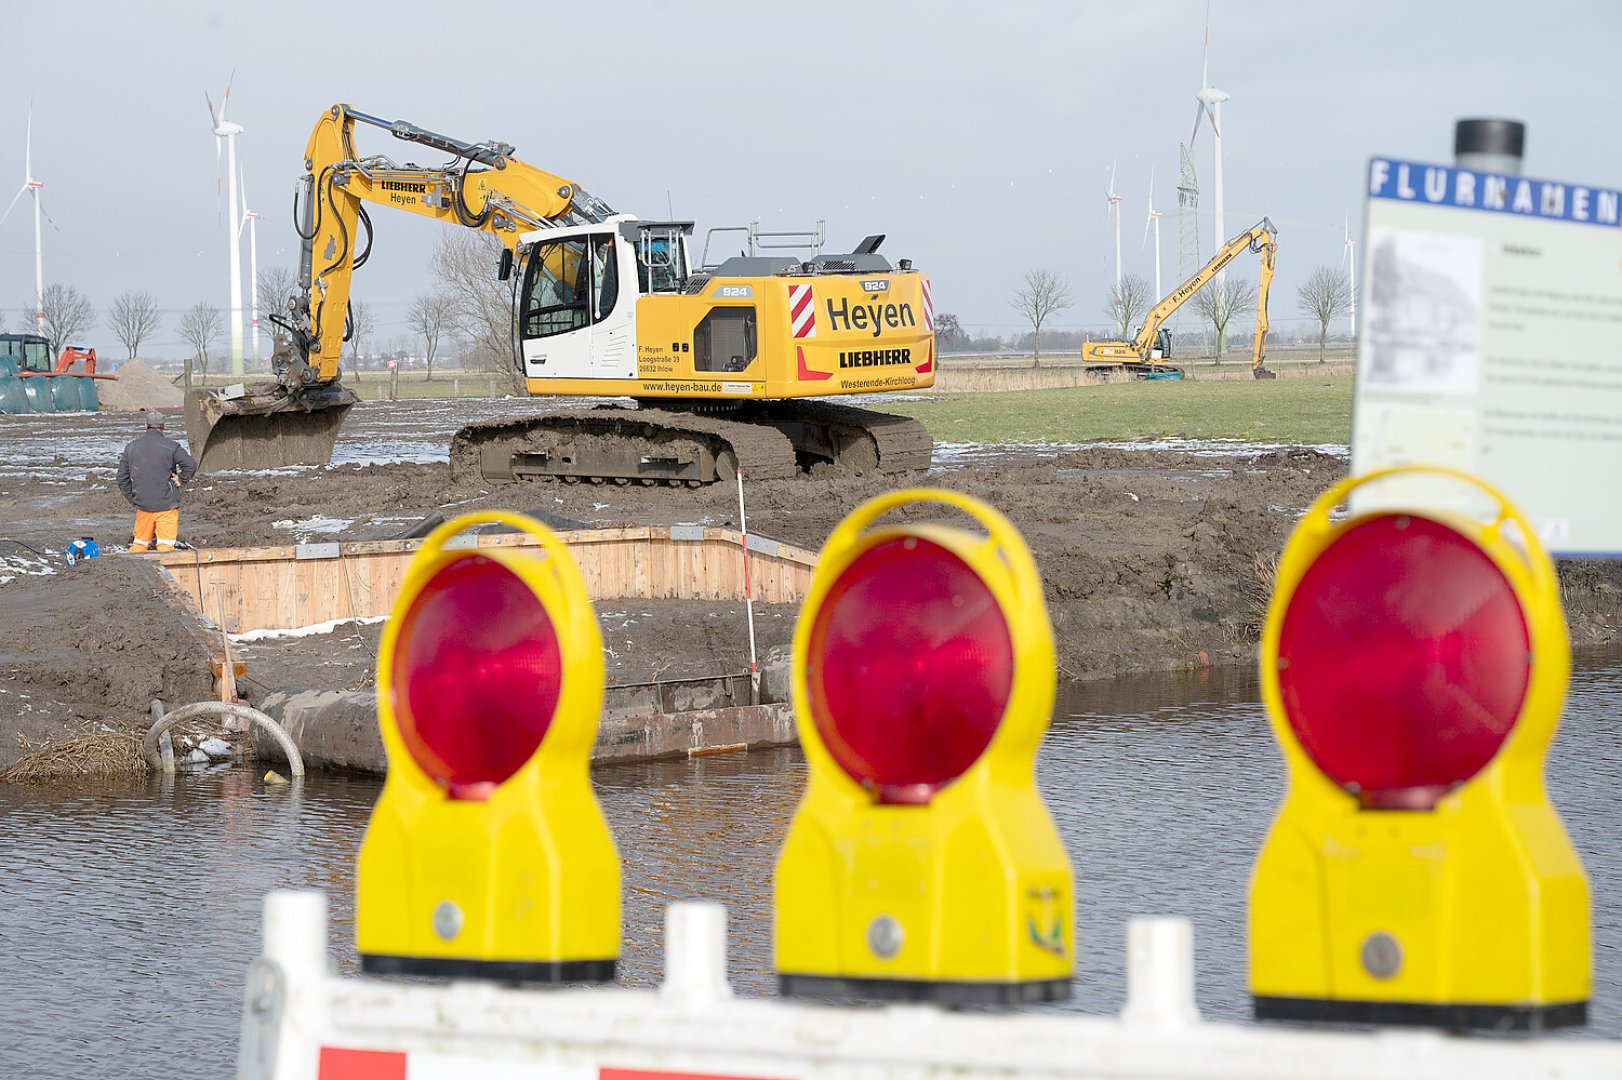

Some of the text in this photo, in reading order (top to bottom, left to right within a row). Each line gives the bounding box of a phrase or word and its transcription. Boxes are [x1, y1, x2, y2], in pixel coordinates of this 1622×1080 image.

[381, 180, 426, 193] LIEBHERR
[1370, 159, 1618, 224] FLURNAMEN
[390, 192, 416, 205] Heyen
[722, 287, 748, 297] 924
[864, 281, 886, 291] 924
[1178, 277, 1201, 298] Heyen
[826, 297, 916, 338] Heyen
[638, 345, 664, 354] F. Heyen
[839, 348, 911, 368] LIEBHERR
[643, 381, 722, 393] www.heyen-bau.de
[841, 376, 916, 389] Westerende-Kirchloog
